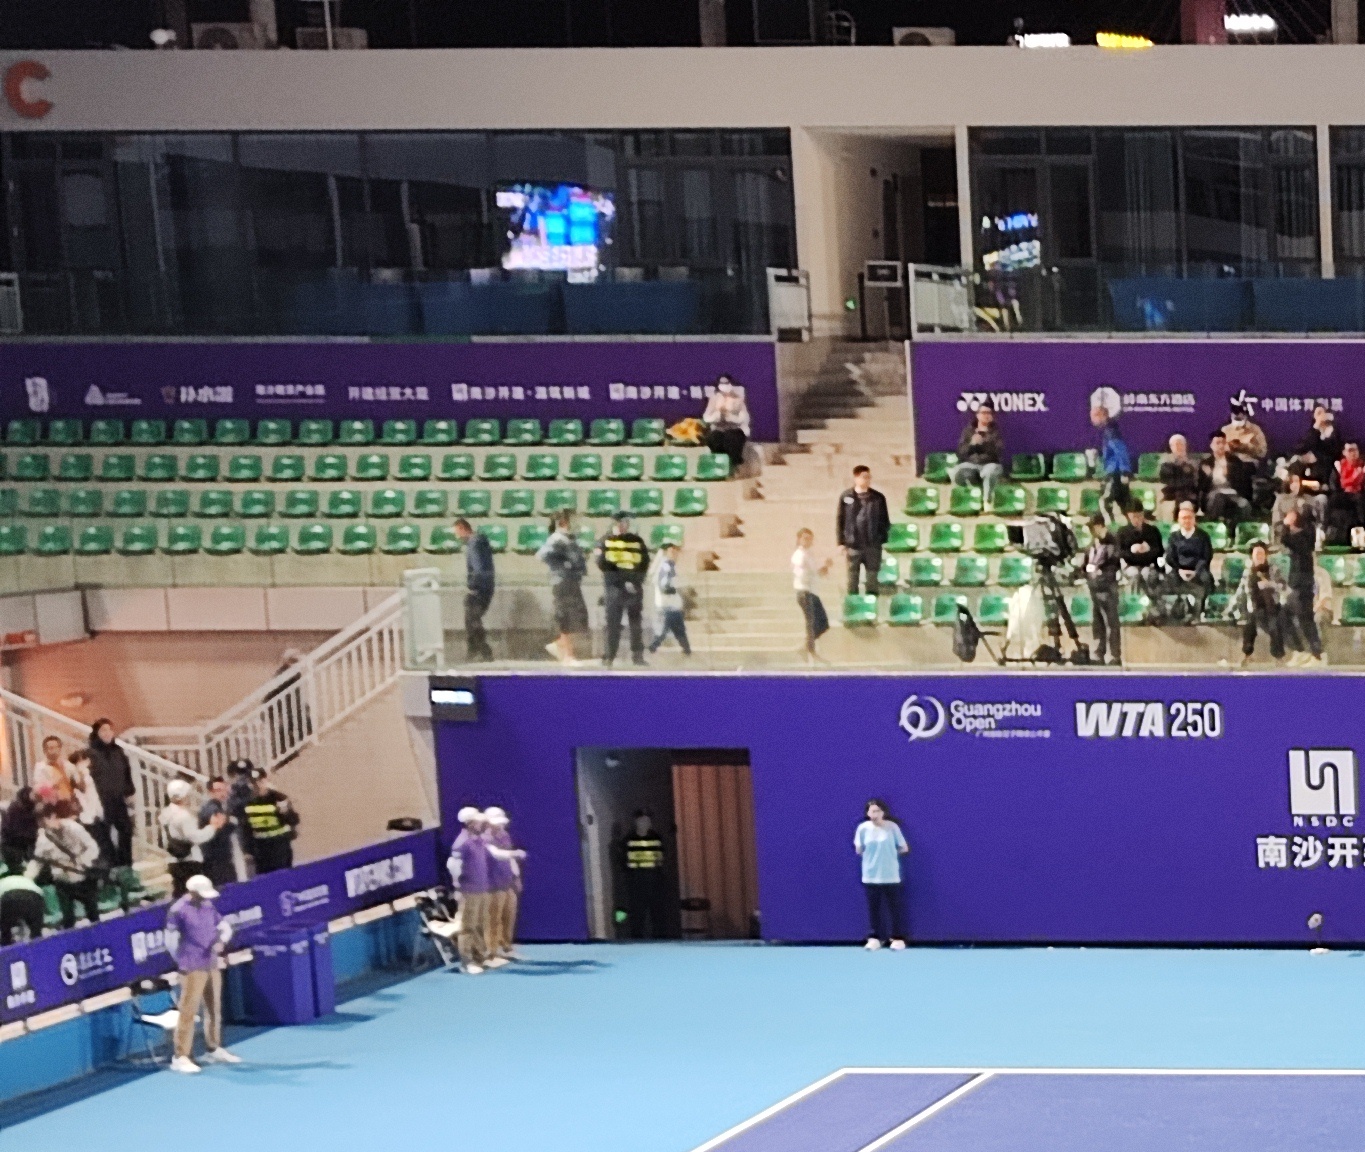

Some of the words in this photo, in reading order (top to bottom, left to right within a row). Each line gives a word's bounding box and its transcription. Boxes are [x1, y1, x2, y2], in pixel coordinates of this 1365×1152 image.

[4, 60, 52, 119] C
[990, 392, 1047, 412] YONEX
[950, 700, 1041, 720] Guangzhou
[1076, 702, 1164, 737] WTA
[1170, 702, 1221, 737] 250
[951, 716, 995, 732] Open
[1293, 815, 1354, 828] NSDC
